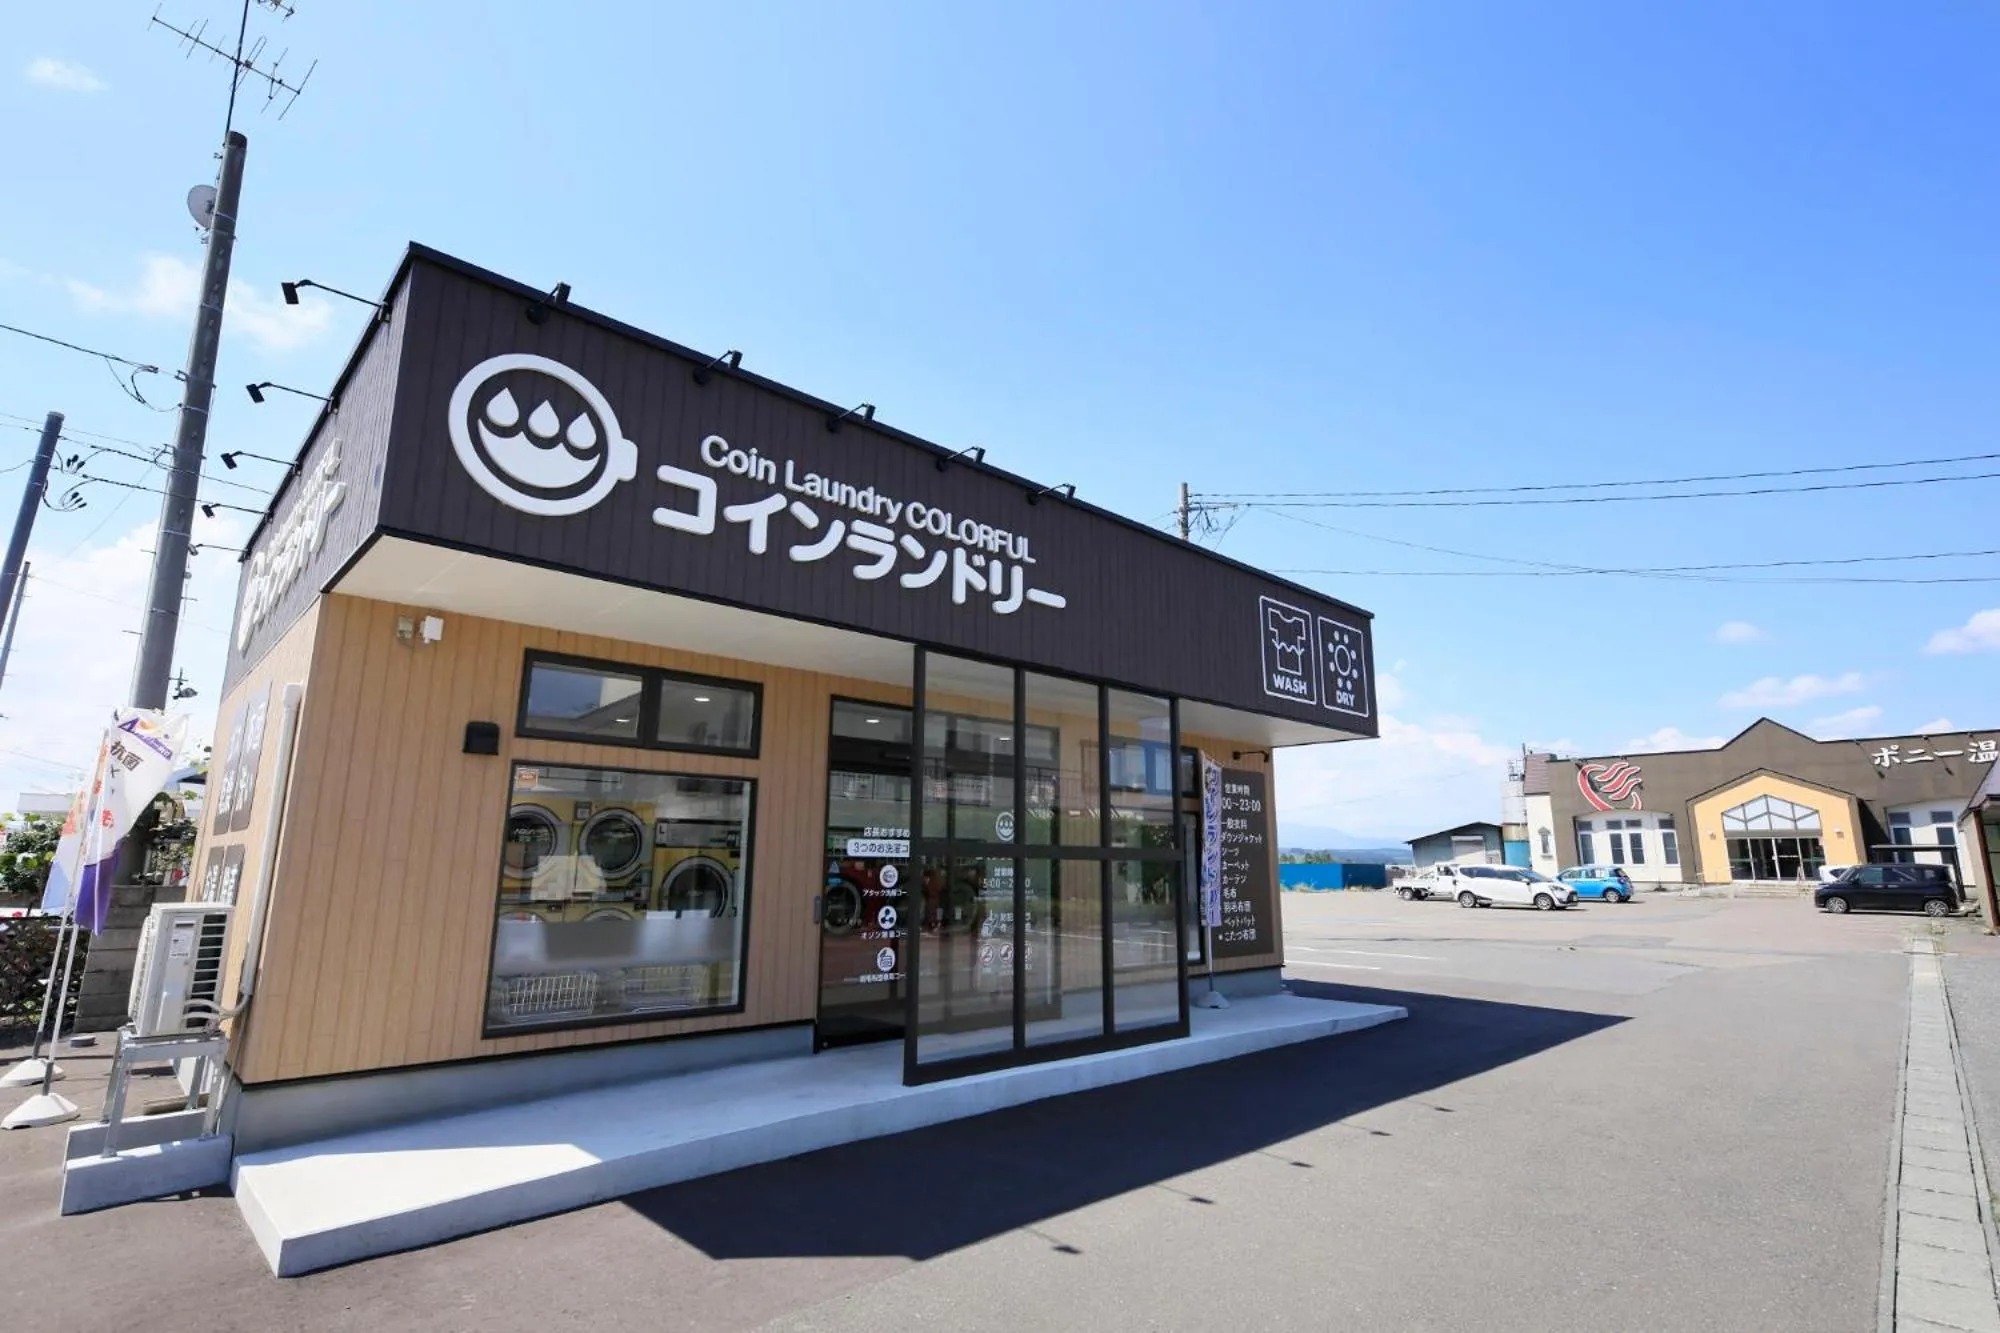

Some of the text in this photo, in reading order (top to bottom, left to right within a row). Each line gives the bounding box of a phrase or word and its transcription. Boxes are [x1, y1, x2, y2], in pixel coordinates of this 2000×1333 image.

[701, 435, 1037, 564] Coin Laundry COLORFUL
[652, 464, 1067, 614] コインランドリー
[1272, 673, 1308, 695] WASH
[1335, 690, 1355, 707] DRY
[1871, 740, 1999, 768] ポニー温
